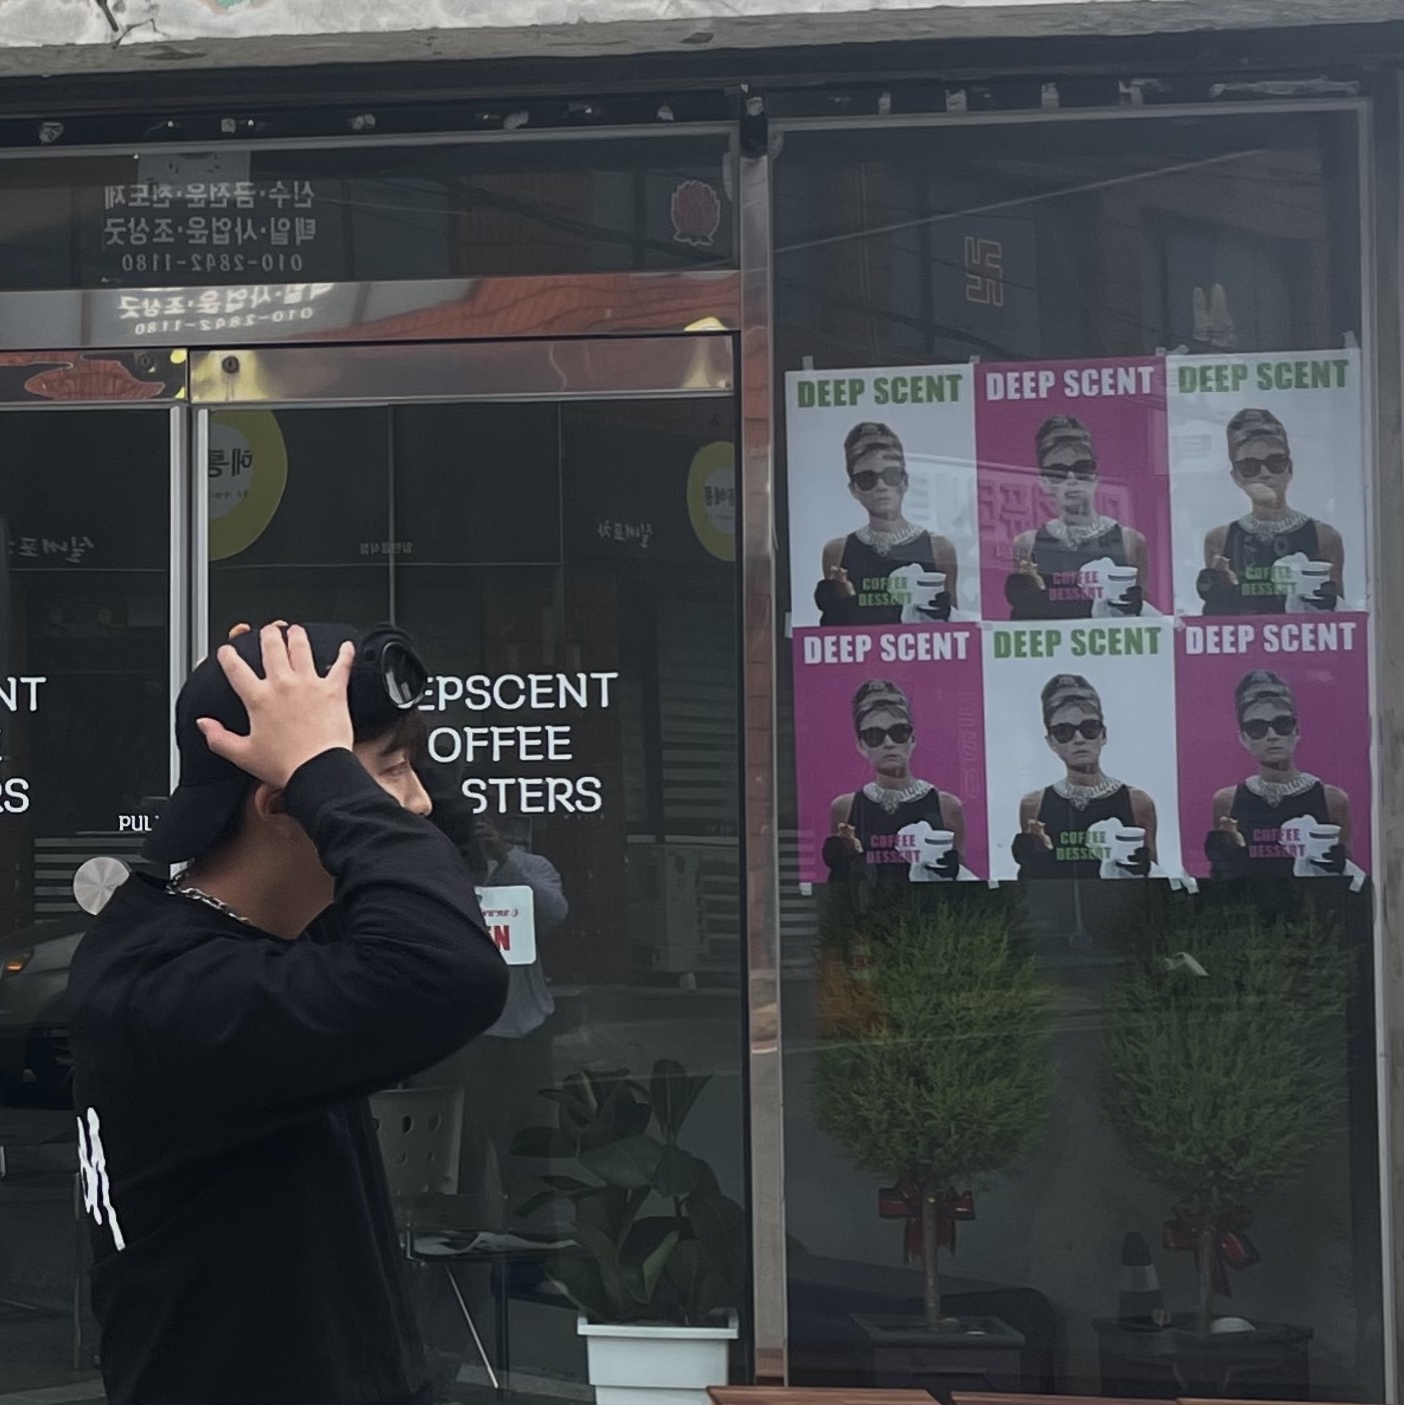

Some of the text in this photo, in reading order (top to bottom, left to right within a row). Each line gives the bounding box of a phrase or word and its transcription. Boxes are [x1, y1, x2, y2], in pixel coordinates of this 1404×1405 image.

[797, 373, 963, 408] DEEP SCENT
[985, 366, 1154, 401] DEEP SCENT
[1178, 359, 1350, 393] DEEP SCENT
[803, 631, 970, 664] DEEP SCENT
[993, 626, 1162, 659] DEEP SCENT
[1185, 622, 1357, 655] DEEP SCENT
[418, 672, 620, 711] EPSCENT
[428, 725, 573, 763] OFFEE
[461, 776, 602, 814] STERS
[118, 814, 160, 832] PUL
